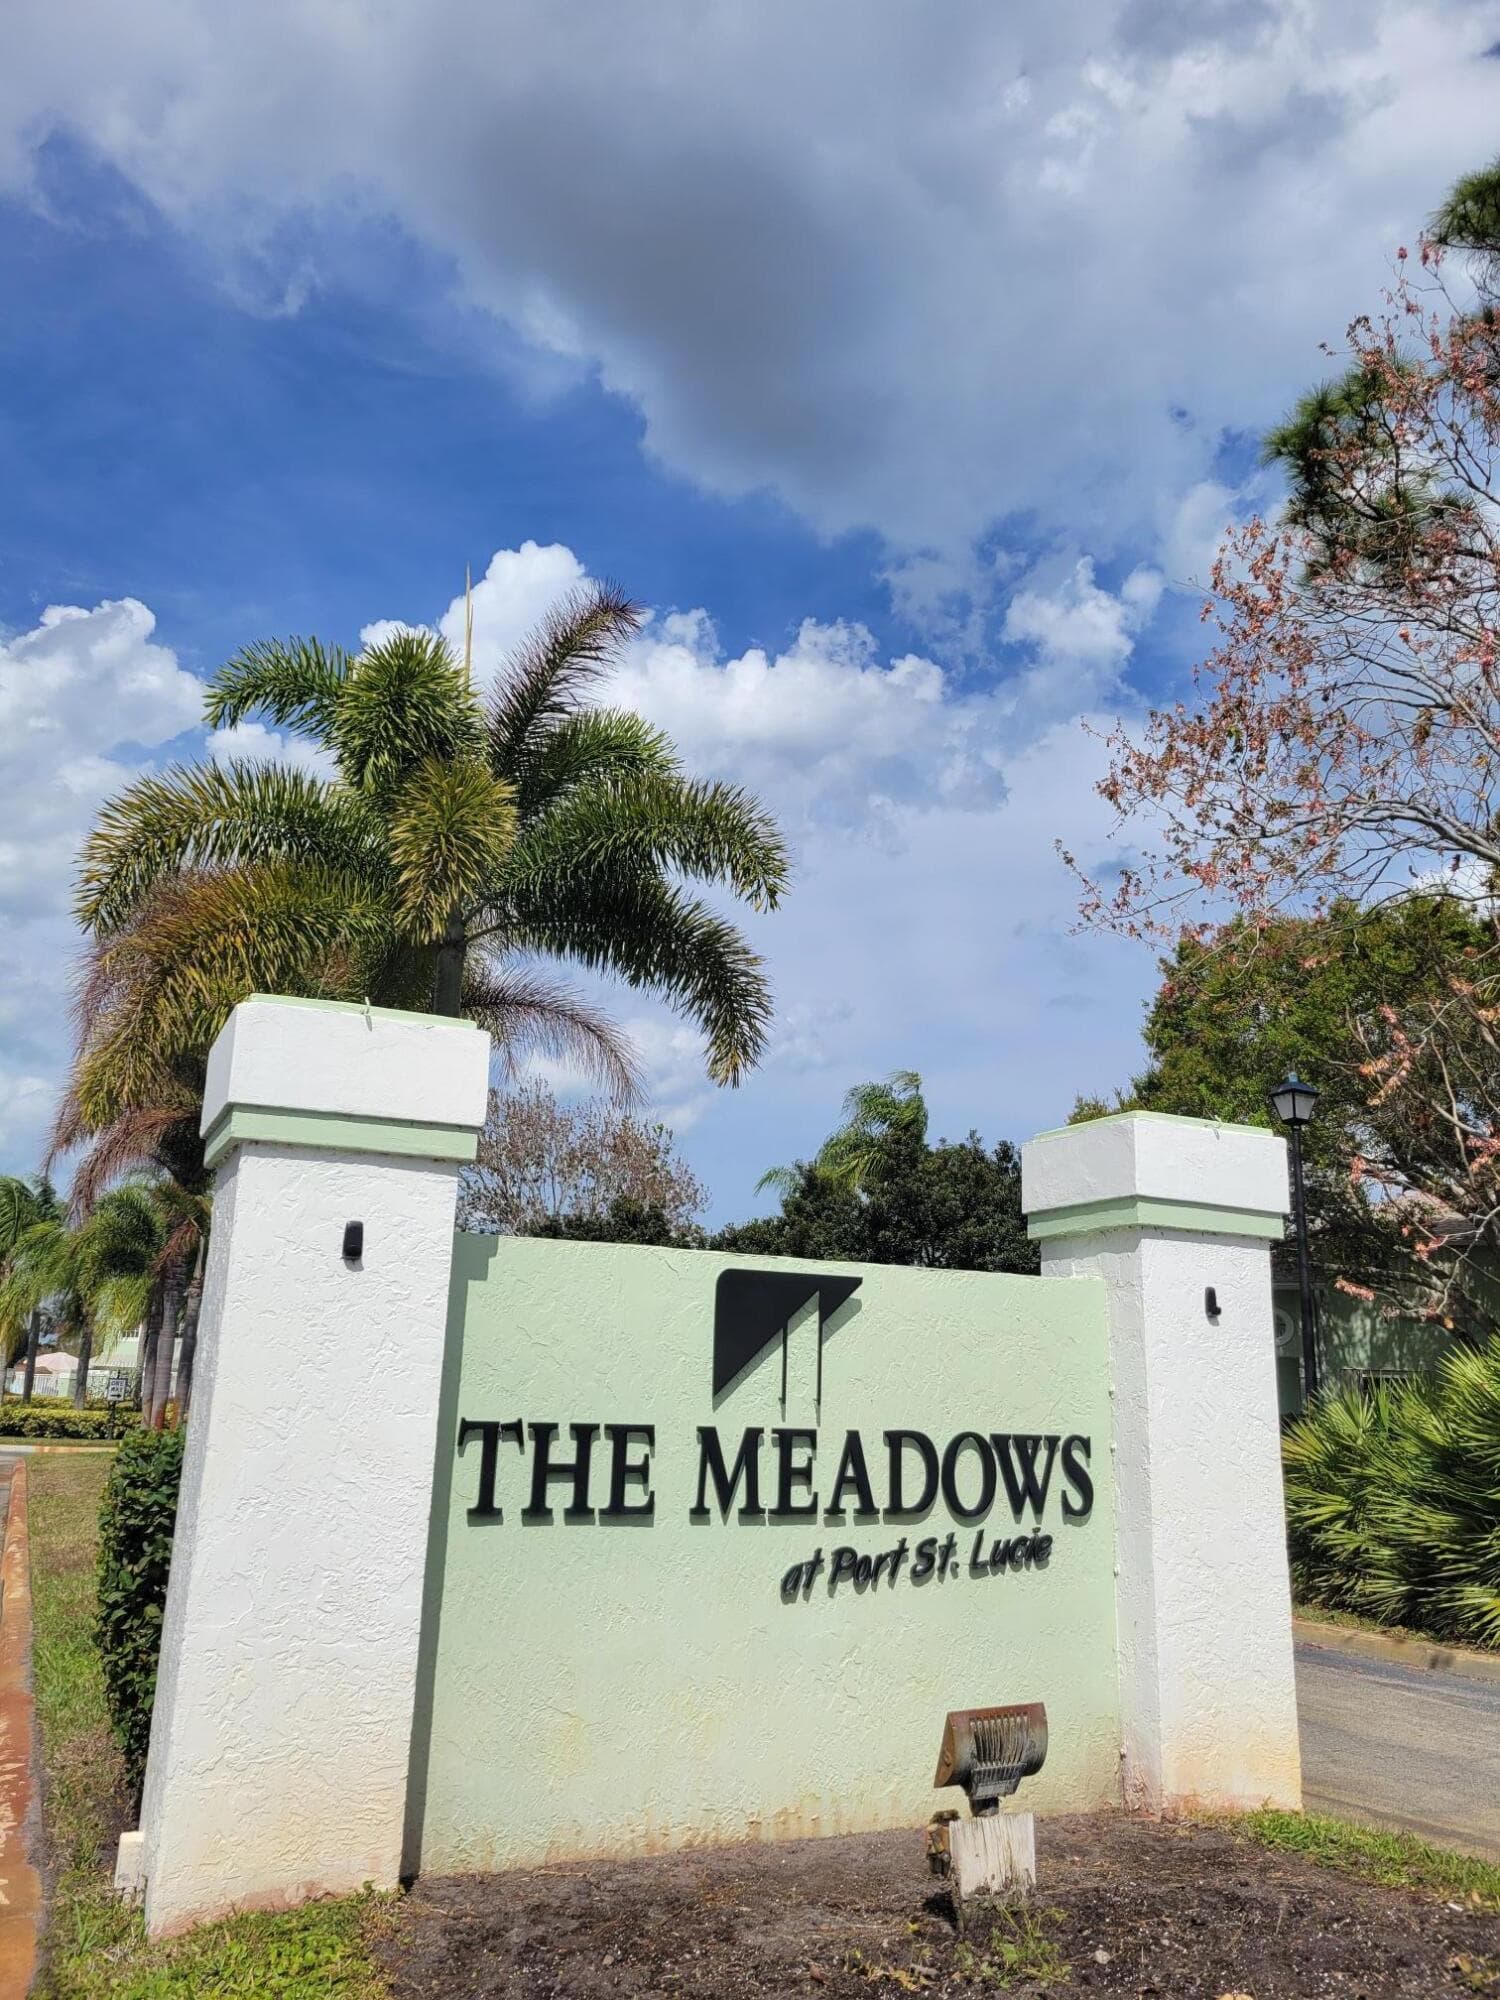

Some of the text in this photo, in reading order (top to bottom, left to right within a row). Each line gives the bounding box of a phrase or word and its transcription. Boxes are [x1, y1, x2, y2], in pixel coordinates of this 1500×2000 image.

[457, 1417, 1094, 1517] THE MEADOWS
[782, 1527, 1054, 1595] at Port St. Lucie
